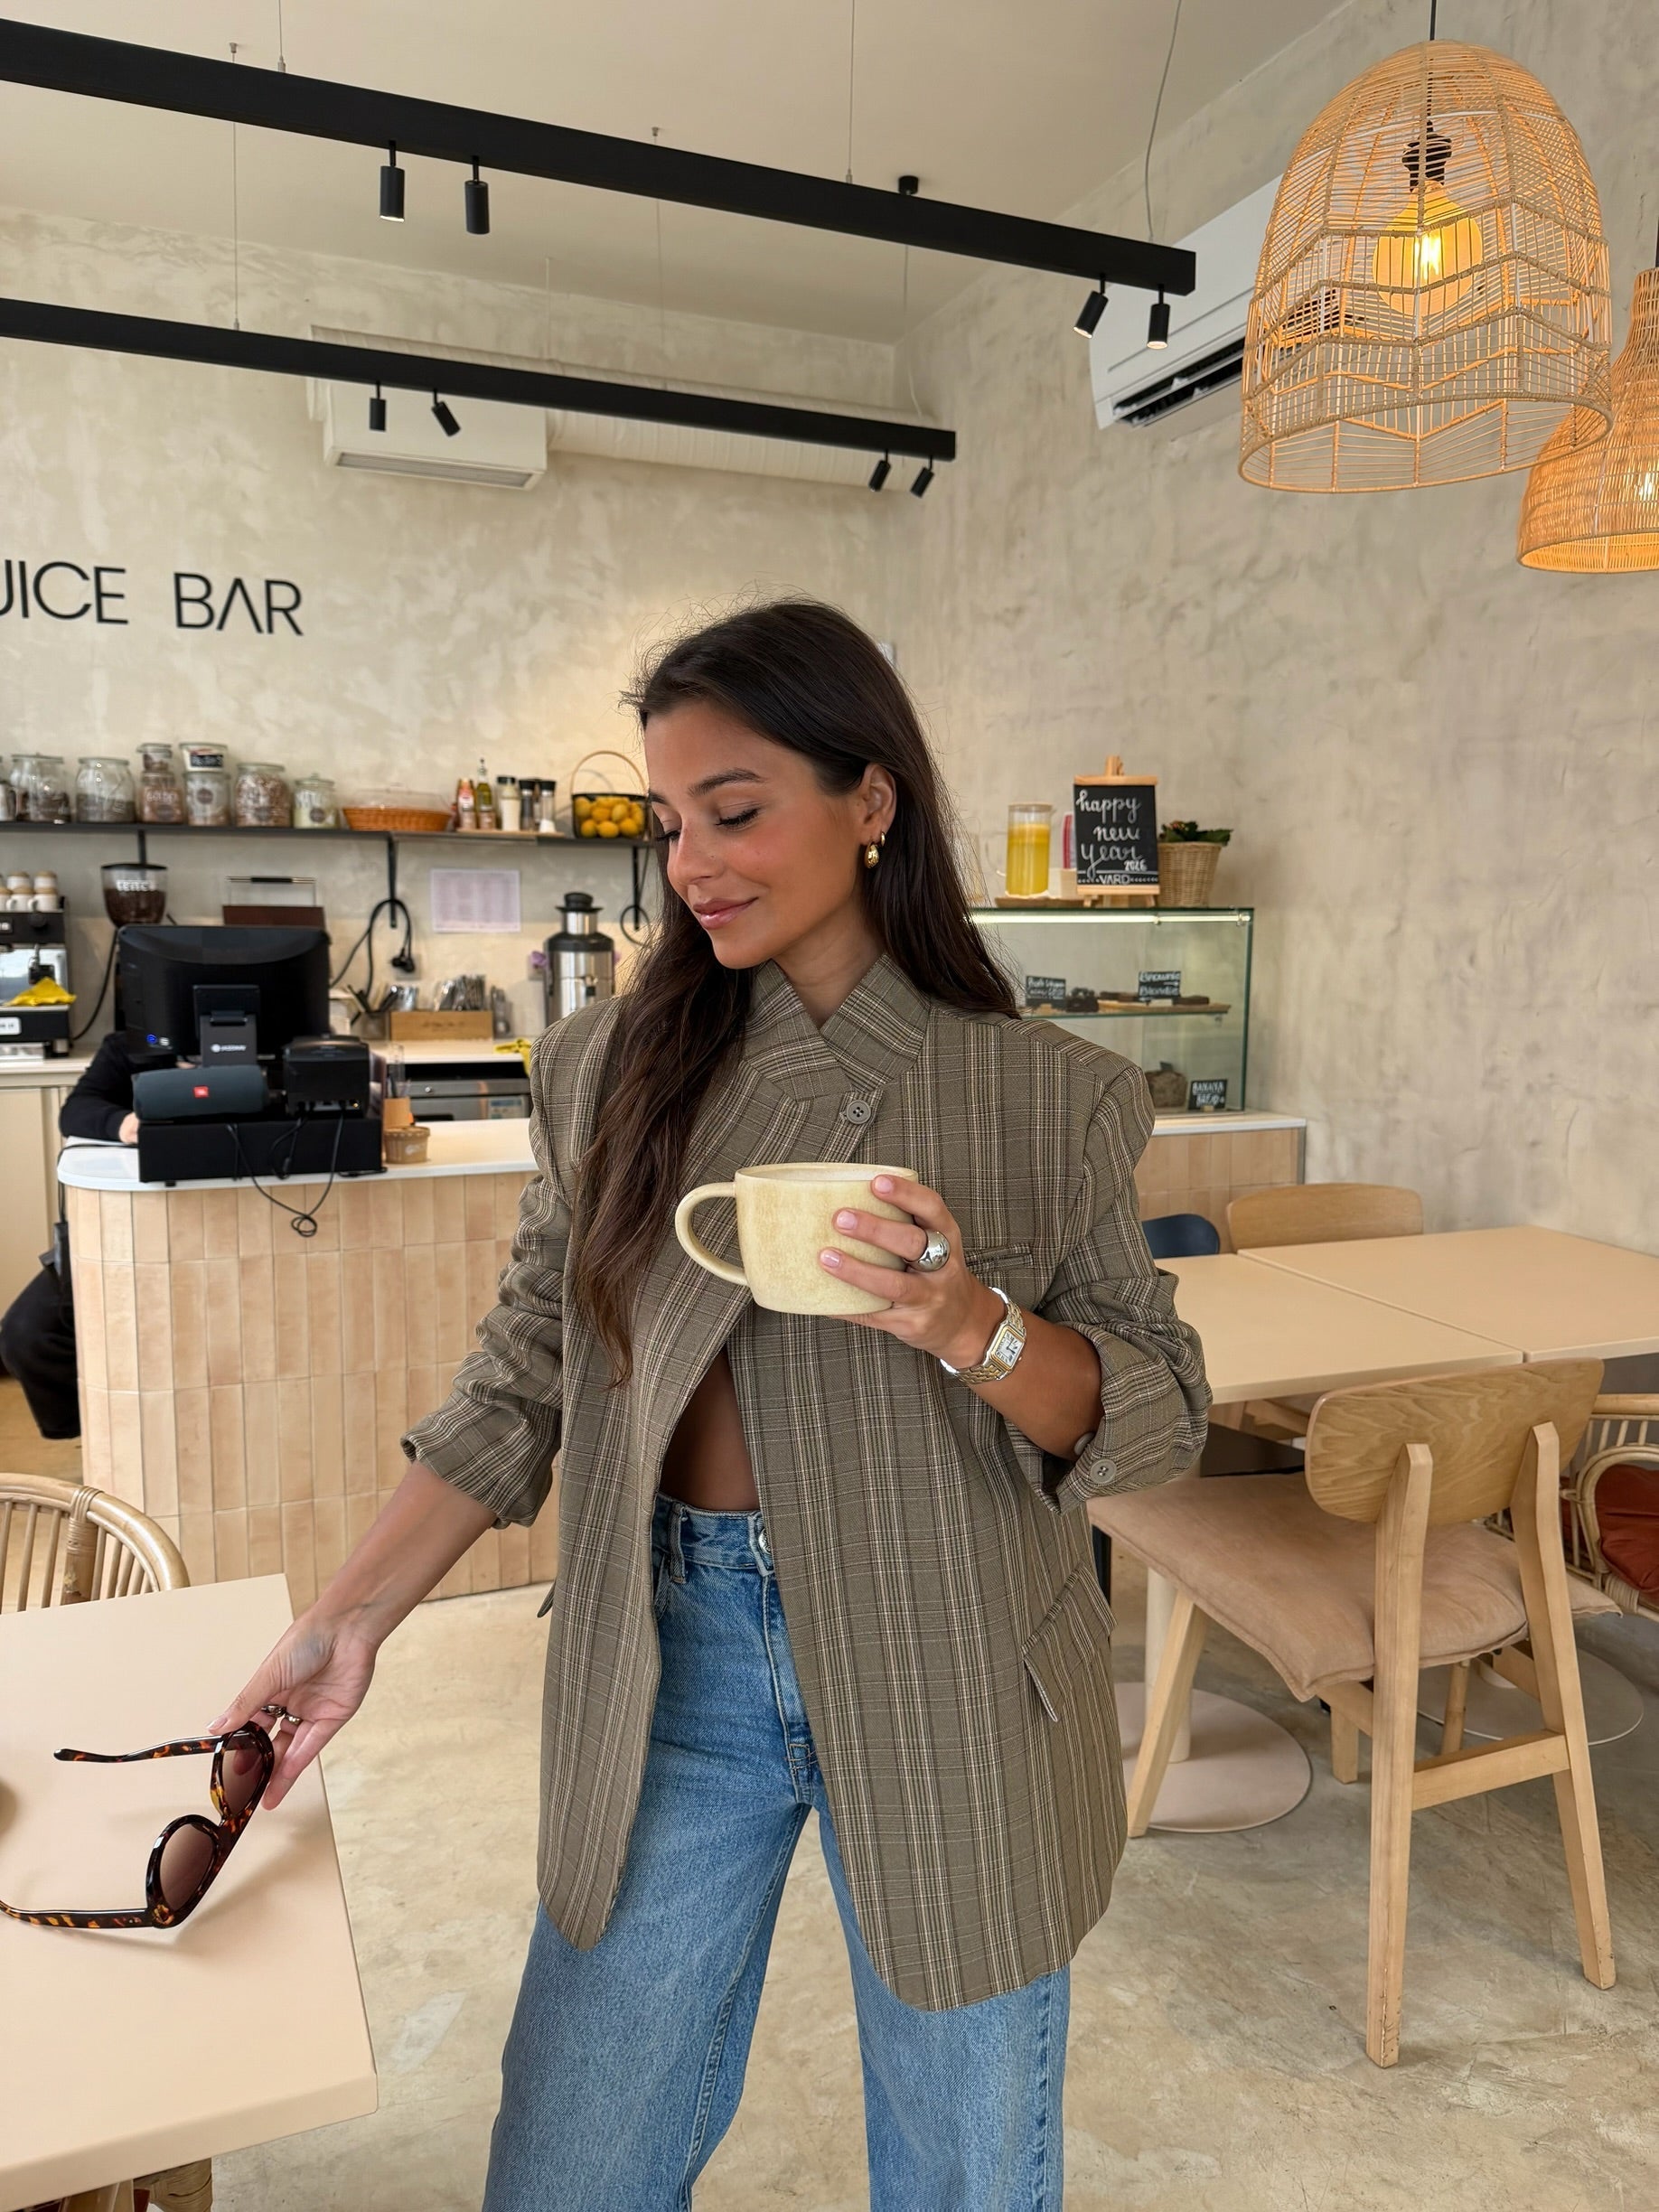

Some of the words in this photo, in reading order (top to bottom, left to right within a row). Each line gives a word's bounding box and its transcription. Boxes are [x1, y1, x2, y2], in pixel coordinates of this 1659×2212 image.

[173, 572, 304, 636] BAR
[1075, 789, 1142, 824] happy
[1092, 826, 1140, 842] new
